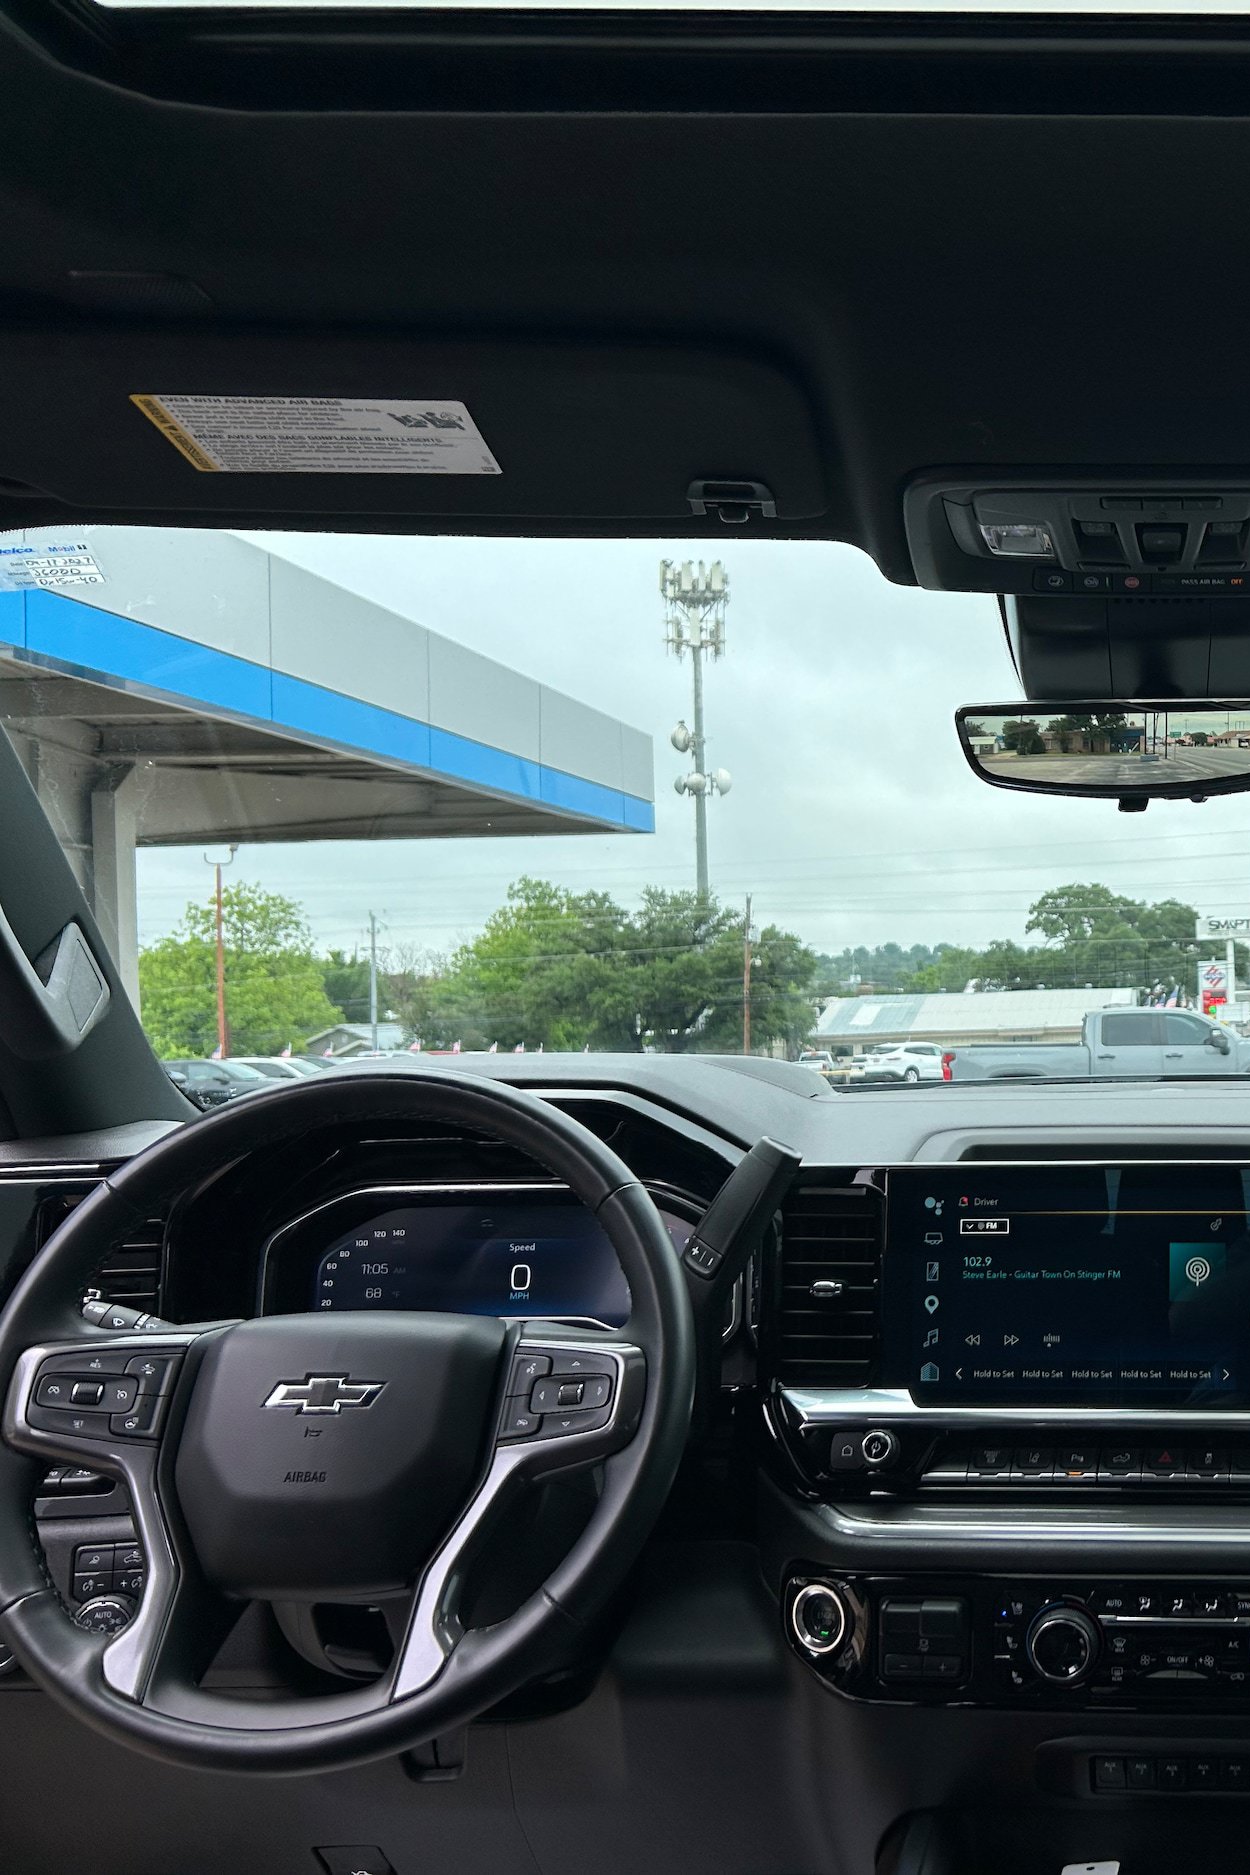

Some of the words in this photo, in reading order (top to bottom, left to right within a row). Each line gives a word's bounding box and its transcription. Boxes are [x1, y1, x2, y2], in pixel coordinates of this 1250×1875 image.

[224, 398, 286, 406] ADVANCED
[48, 544, 76, 553] Mobil
[974, 1197, 999, 1206] Driver
[985, 1222, 998, 1230] FM
[392, 1229, 406, 1237] 140
[509, 1243, 536, 1253] Speed
[339, 1250, 351, 1258] 80
[326, 1262, 337, 1270] 60
[963, 1256, 993, 1267] 102.9
[361, 1263, 389, 1275] 11:05
[511, 1264, 531, 1290] 0
[962, 1270, 985, 1279] Steve
[986, 1270, 1007, 1279] Earle
[1014, 1270, 1039, 1279] Guitar
[1041, 1270, 1062, 1279] Town
[1063, 1270, 1075, 1279] On
[1077, 1270, 1106, 1281] Stinger
[1107, 1270, 1121, 1279] FM
[323, 1280, 333, 1288] 40
[365, 1287, 382, 1299] 68
[509, 1292, 530, 1300] MPH
[321, 1299, 331, 1307] 20
[973, 1369, 991, 1378] Hold
[1002, 1369, 1014, 1378] Set
[1022, 1369, 1040, 1378] Hold
[1051, 1369, 1063, 1378] Set
[1071, 1369, 1089, 1378] Hold
[1100, 1369, 1112, 1378] Set
[1120, 1369, 1138, 1378] Hold
[1150, 1369, 1162, 1378] Set
[1170, 1369, 1188, 1378] Hold
[1199, 1369, 1211, 1378] Set
[283, 1471, 328, 1483] AIRBAG
[1106, 1599, 1122, 1607] AUTO
[94, 1611, 112, 1619] AUTO
[1228, 1641, 1239, 1649] A/C
[1167, 1656, 1188, 1664] ON/OFF
